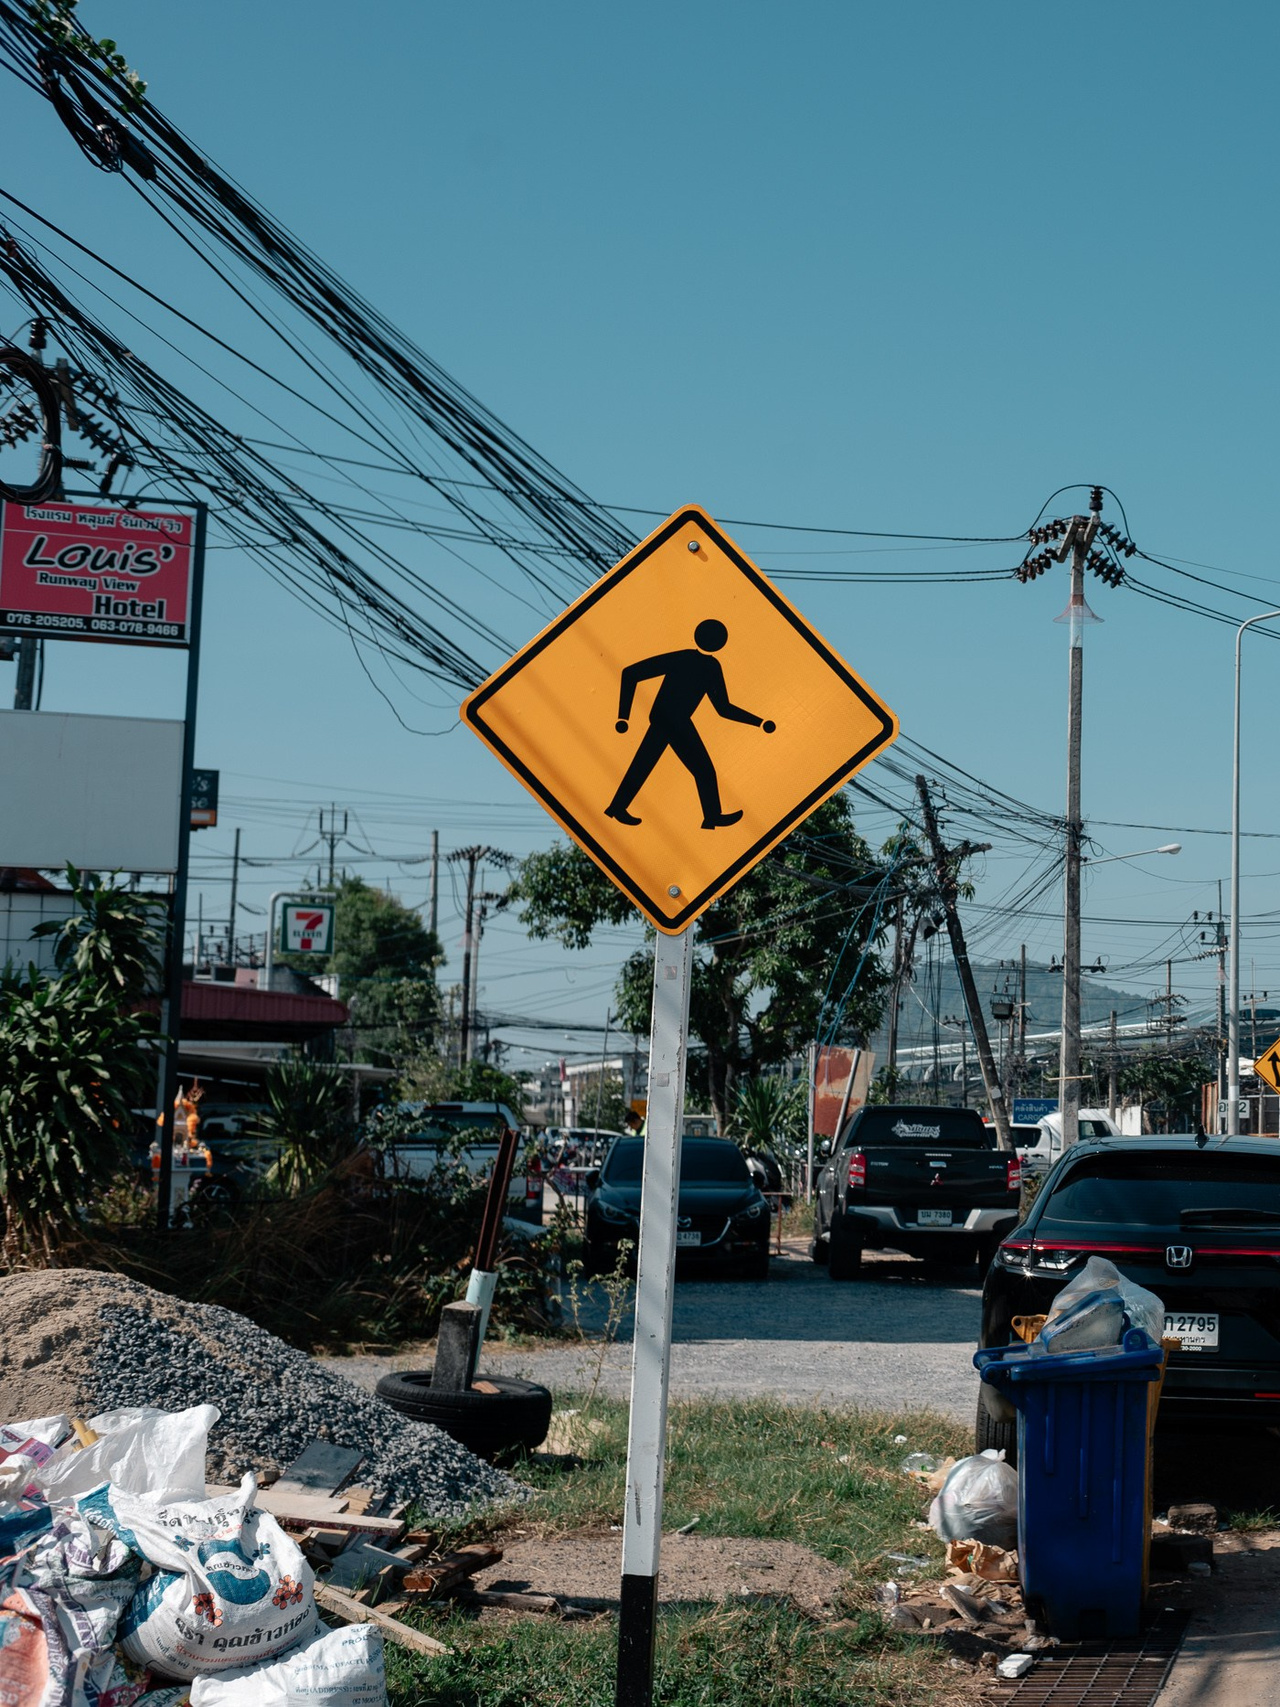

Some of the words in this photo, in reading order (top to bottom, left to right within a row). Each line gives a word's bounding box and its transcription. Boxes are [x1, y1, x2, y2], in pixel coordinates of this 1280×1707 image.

[24, 506, 71, 522] โรงแรม
[37, 571, 98, 591] Runway
[102, 577, 139, 592] View
[93, 593, 166, 620] Hotel
[91, 619, 179, 636] 063-078-9466
[296, 912, 323, 950] 7
[1177, 1316, 1216, 1332] 2795
